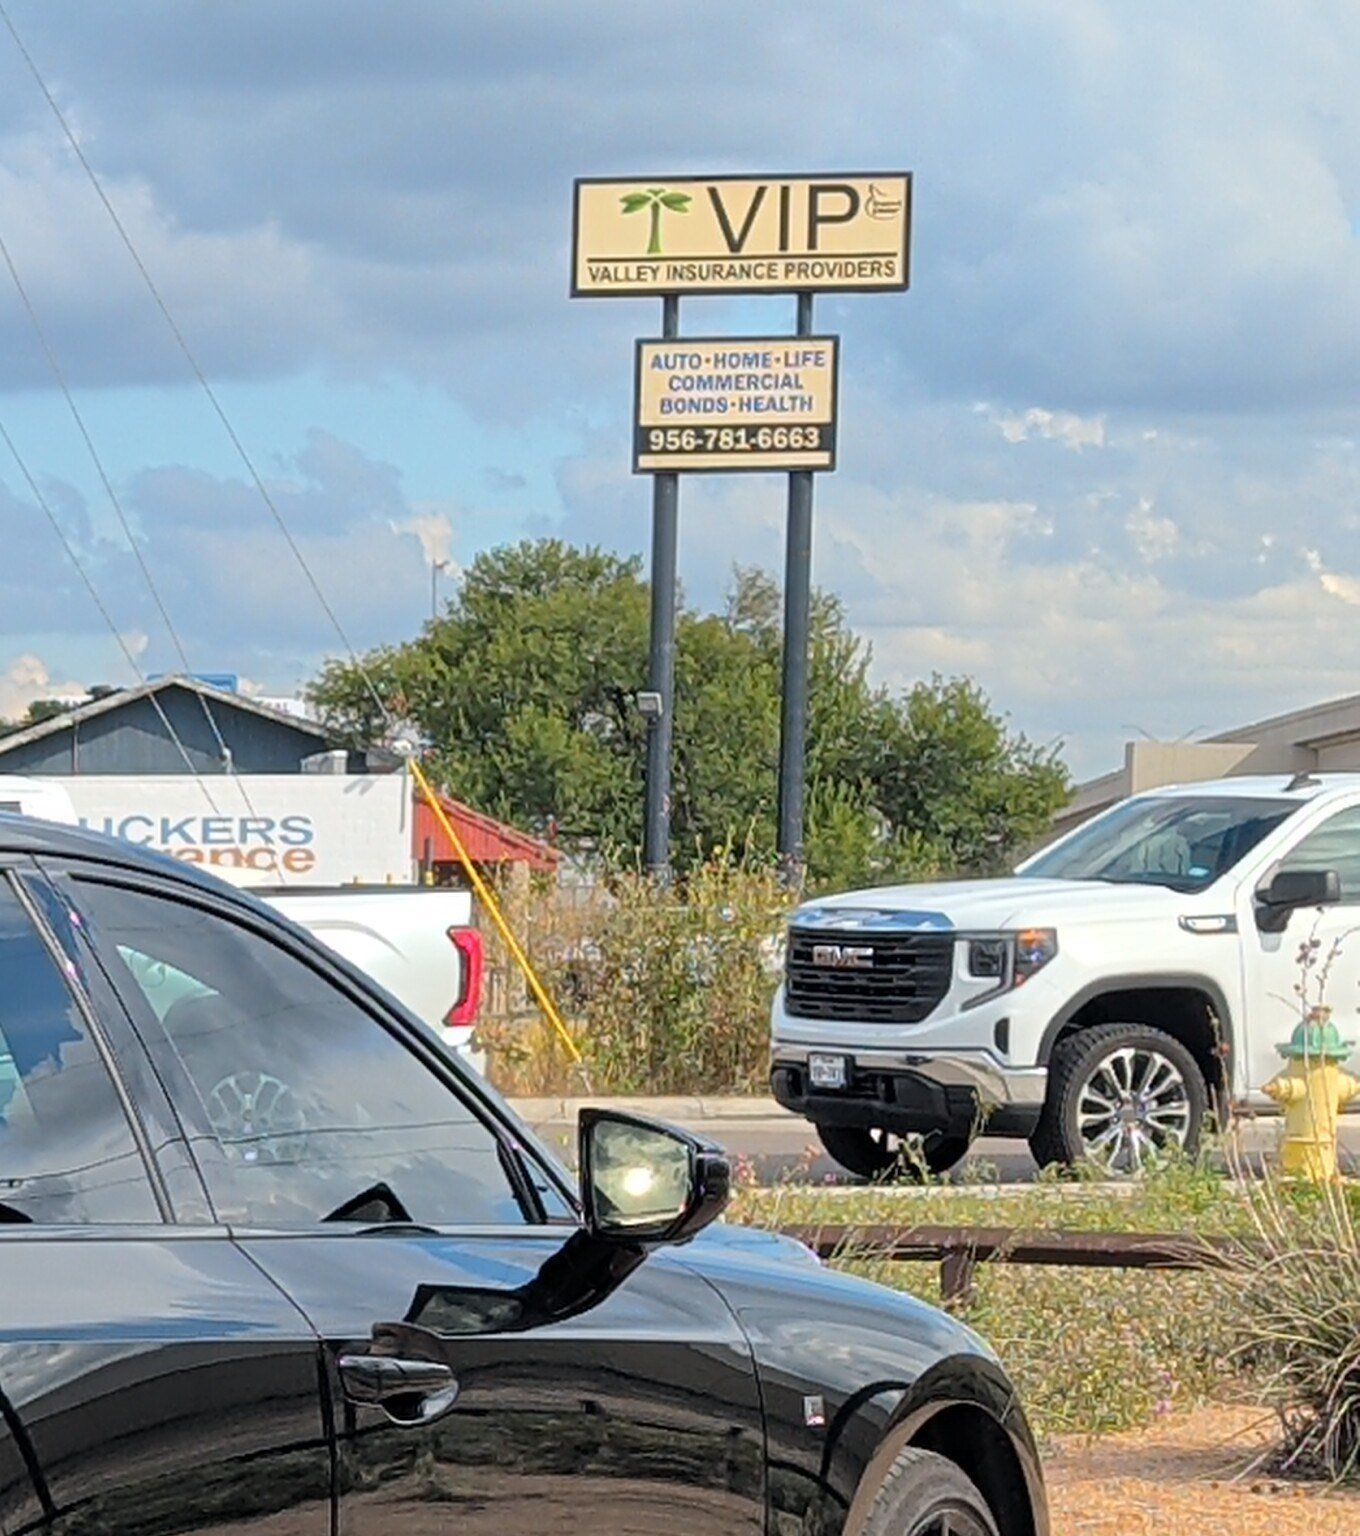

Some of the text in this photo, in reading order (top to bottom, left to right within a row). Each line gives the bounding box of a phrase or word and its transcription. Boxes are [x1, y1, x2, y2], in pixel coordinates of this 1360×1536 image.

[707, 184, 861, 254] VIP
[588, 259, 896, 283] VALLEY INSURANCE PROVIDERS
[651, 350, 826, 370] AUTO HOME LIFE
[668, 373, 804, 391] COMMERCIAL
[660, 395, 814, 414] BONDS HEALTH
[649, 426, 821, 451] 956-781-6663
[165, 847, 316, 873] ance
[813, 945, 874, 968] GMC
